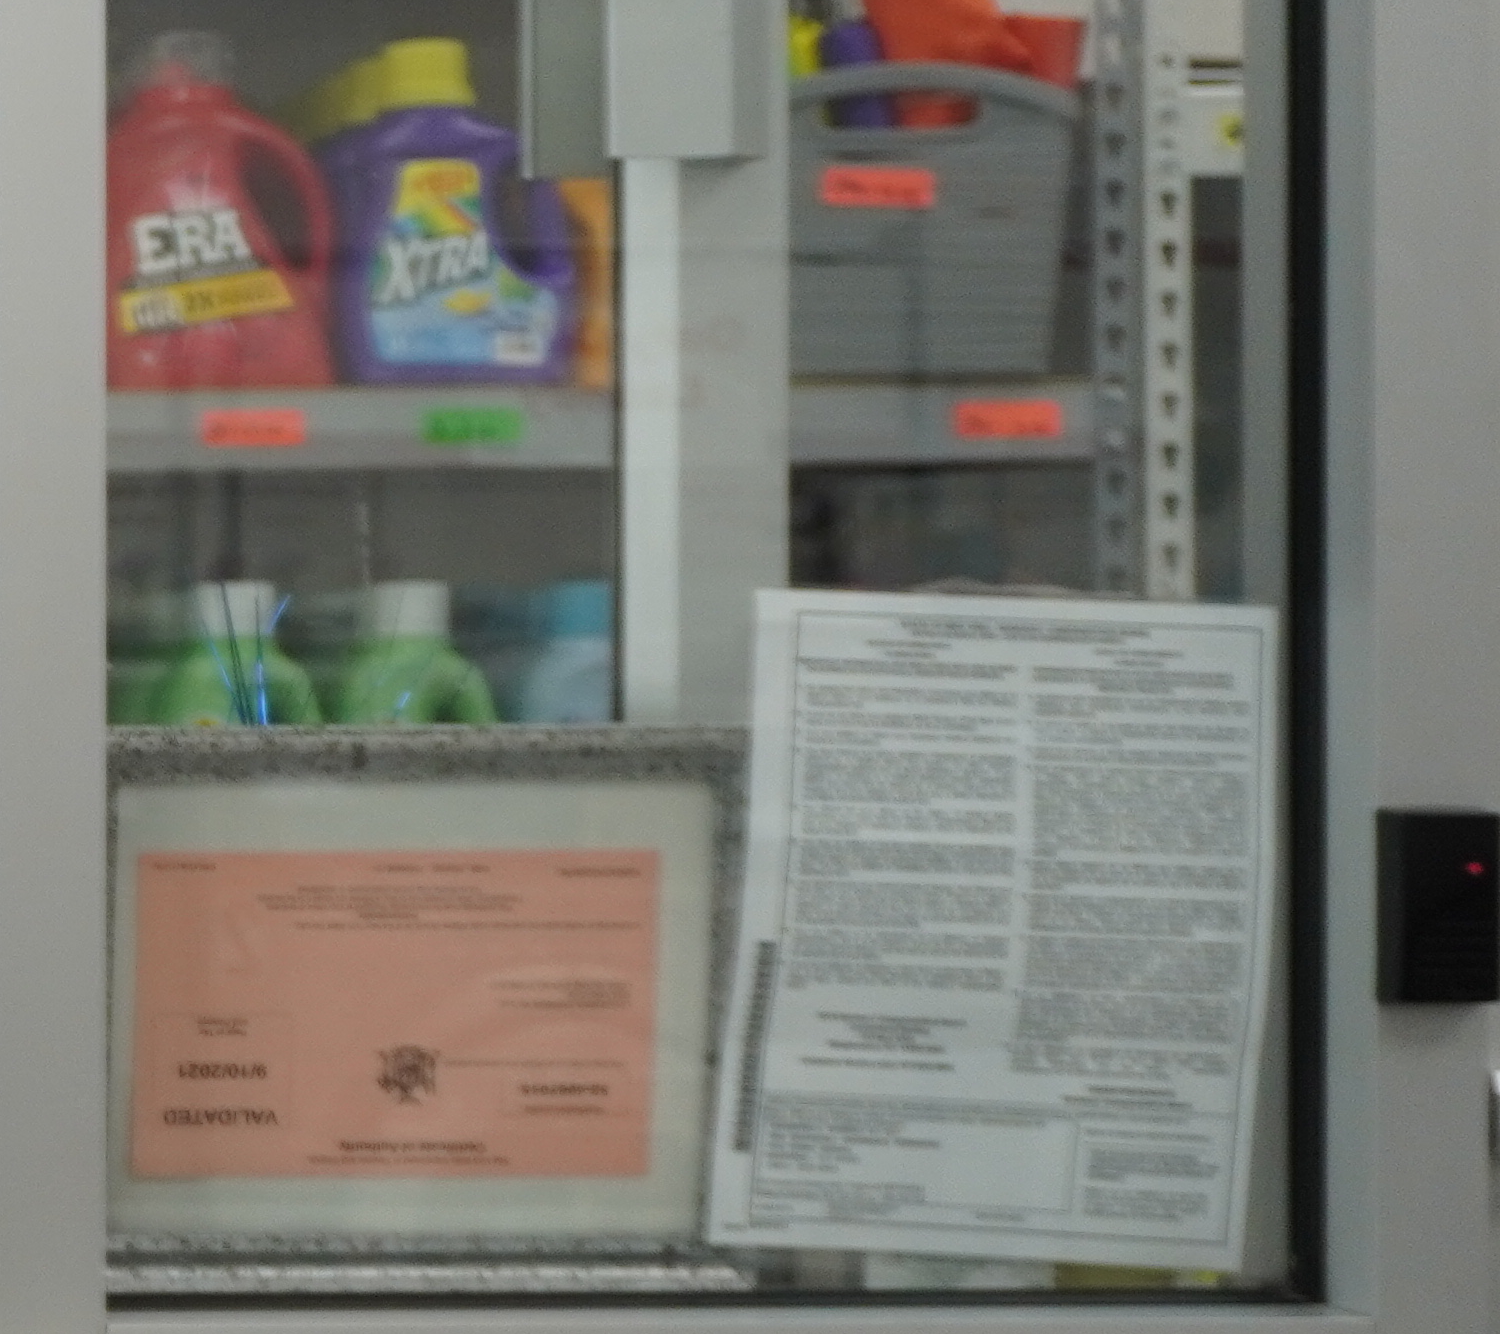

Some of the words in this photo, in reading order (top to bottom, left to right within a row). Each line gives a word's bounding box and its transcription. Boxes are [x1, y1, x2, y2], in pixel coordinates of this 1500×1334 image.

[129, 207, 255, 277] ERA
[375, 231, 491, 306] XTRA
[163, 1107, 279, 1127] VALIDATED
